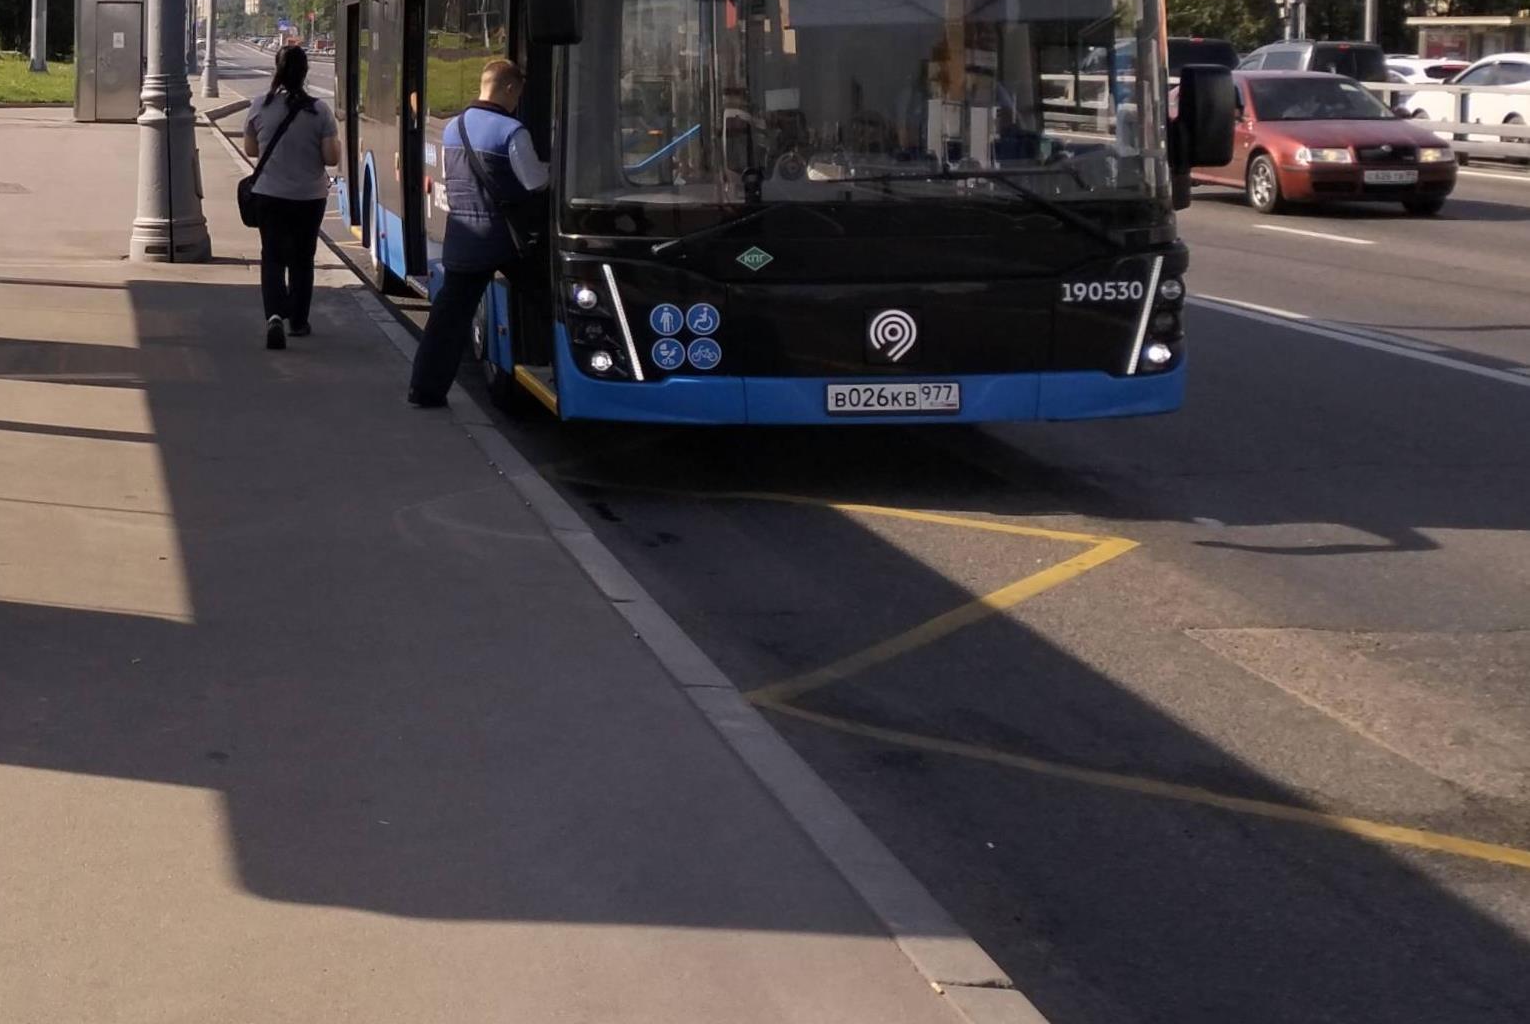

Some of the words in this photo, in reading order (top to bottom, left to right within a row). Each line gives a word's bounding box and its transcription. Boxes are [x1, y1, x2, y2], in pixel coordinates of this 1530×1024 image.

[1061, 280, 1144, 302] 190530
[834, 387, 918, 408] В026КВ
[921, 385, 952, 401] 977
